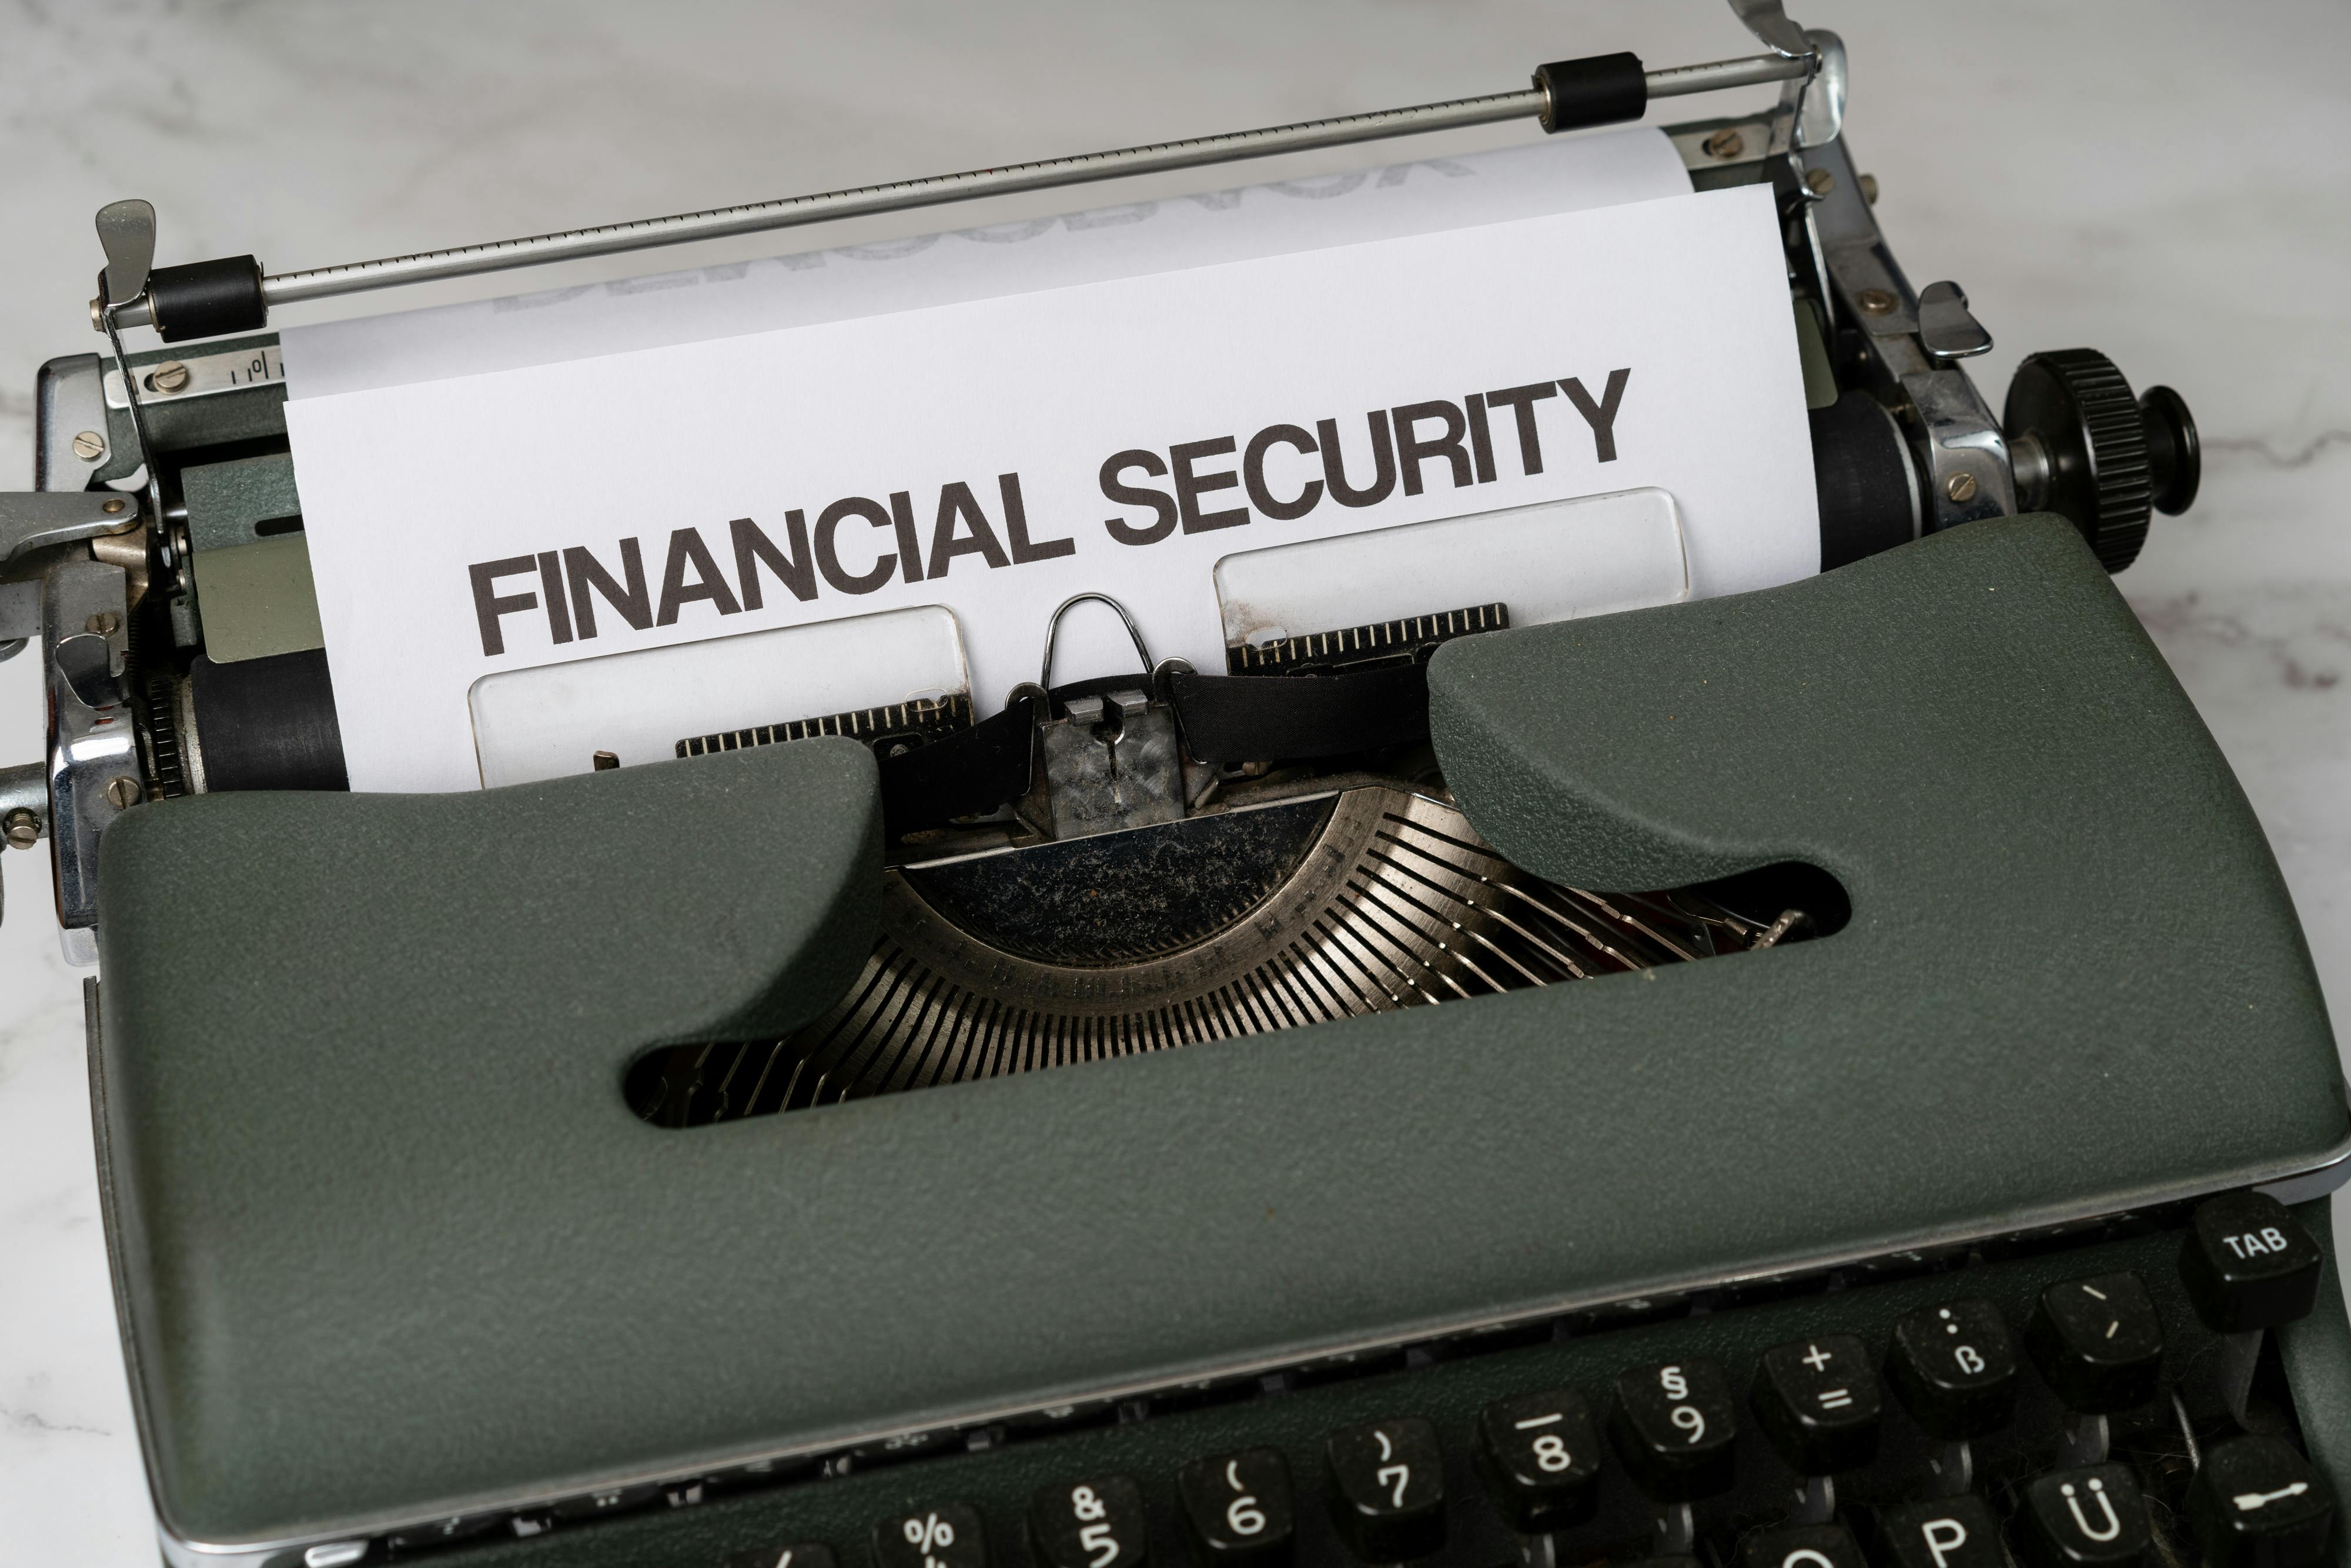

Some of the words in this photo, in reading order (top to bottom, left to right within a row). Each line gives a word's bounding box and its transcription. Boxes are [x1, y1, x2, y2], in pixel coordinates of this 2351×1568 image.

[469, 473, 1076, 657] FINANCIAL
[1099, 368, 1631, 546] SECURITY
[2223, 1228, 2287, 1258] TAB
[1803, 1345, 1831, 1371] +
[1818, 1389, 1852, 1409] =
[1671, 1406, 1704, 1443] 9
[1375, 1431, 1391, 1461] )
[1533, 1435, 1570, 1472] 8
[1227, 1461, 1242, 1490] (
[1378, 1465, 1409, 1507] 7
[1072, 1486, 1105, 1520] &
[1228, 1497, 1265, 1534] 6
[2061, 1478, 2120, 1541] Ü
[904, 1513, 954, 1554] %
[1080, 1523, 1119, 1568] 5
[1922, 1519, 1966, 1568] P
